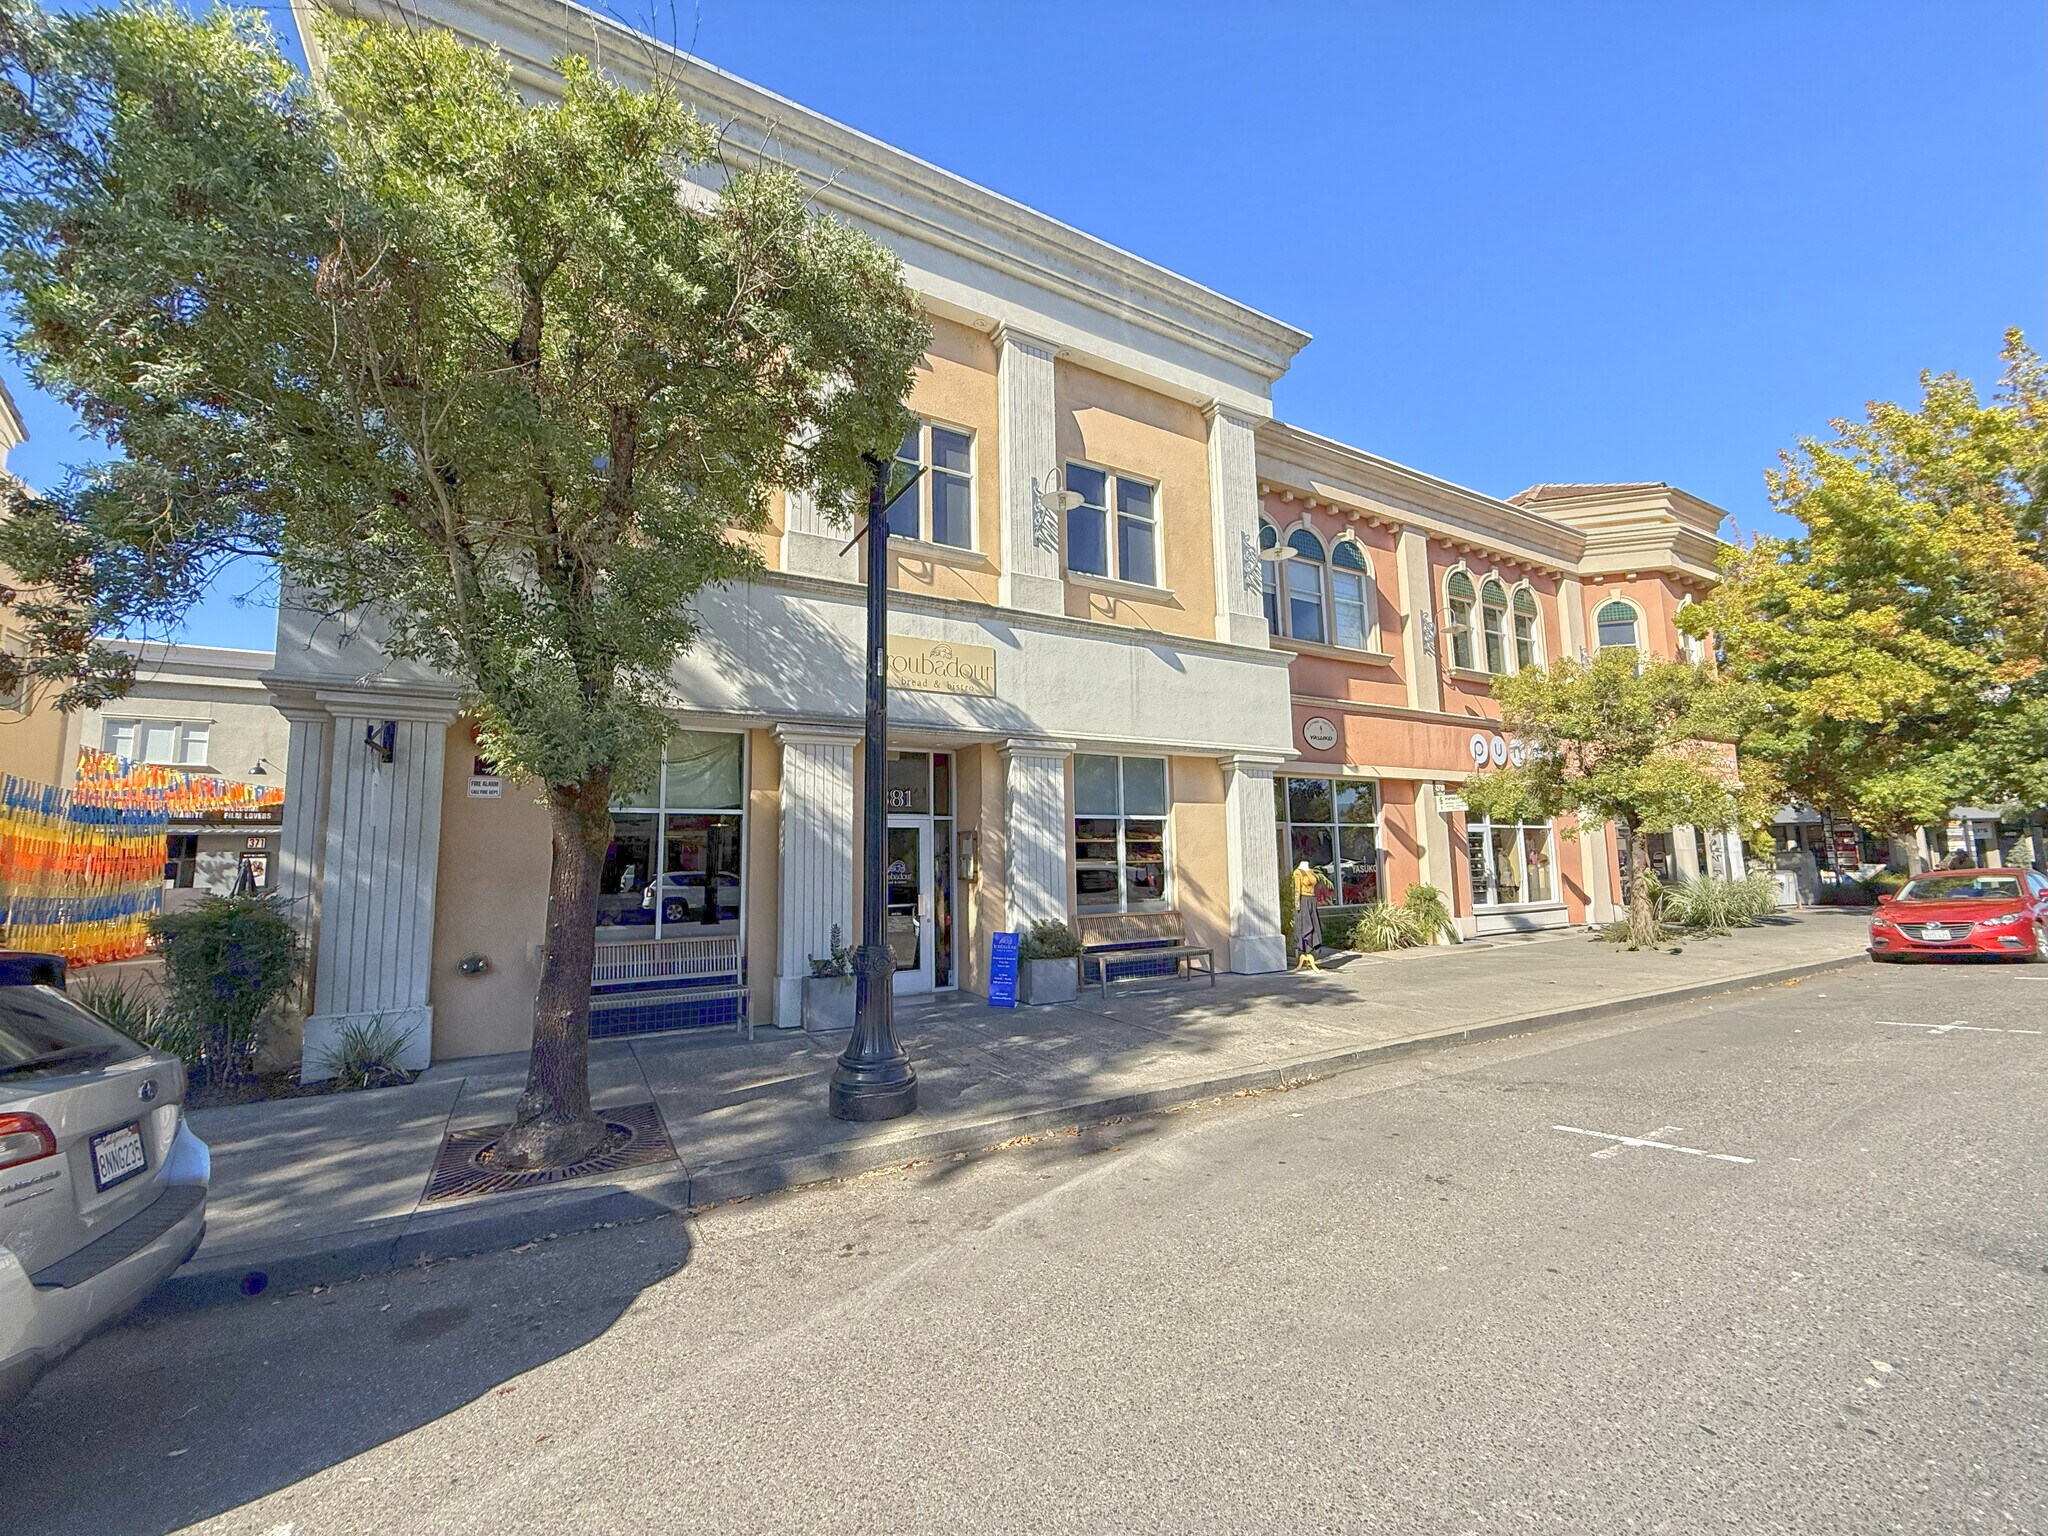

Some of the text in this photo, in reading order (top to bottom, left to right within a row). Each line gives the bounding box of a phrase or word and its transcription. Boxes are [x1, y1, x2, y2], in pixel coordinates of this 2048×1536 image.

[886, 652, 993, 681] roubadour
[901, 677, 974, 691] bread & bistro
[887, 789, 912, 807] 81
[168, 811, 204, 819] YNAMITE
[249, 838, 265, 848] 371
[1352, 864, 1377, 874] YASUKO
[98, 1139, 142, 1178] 8NNG235
